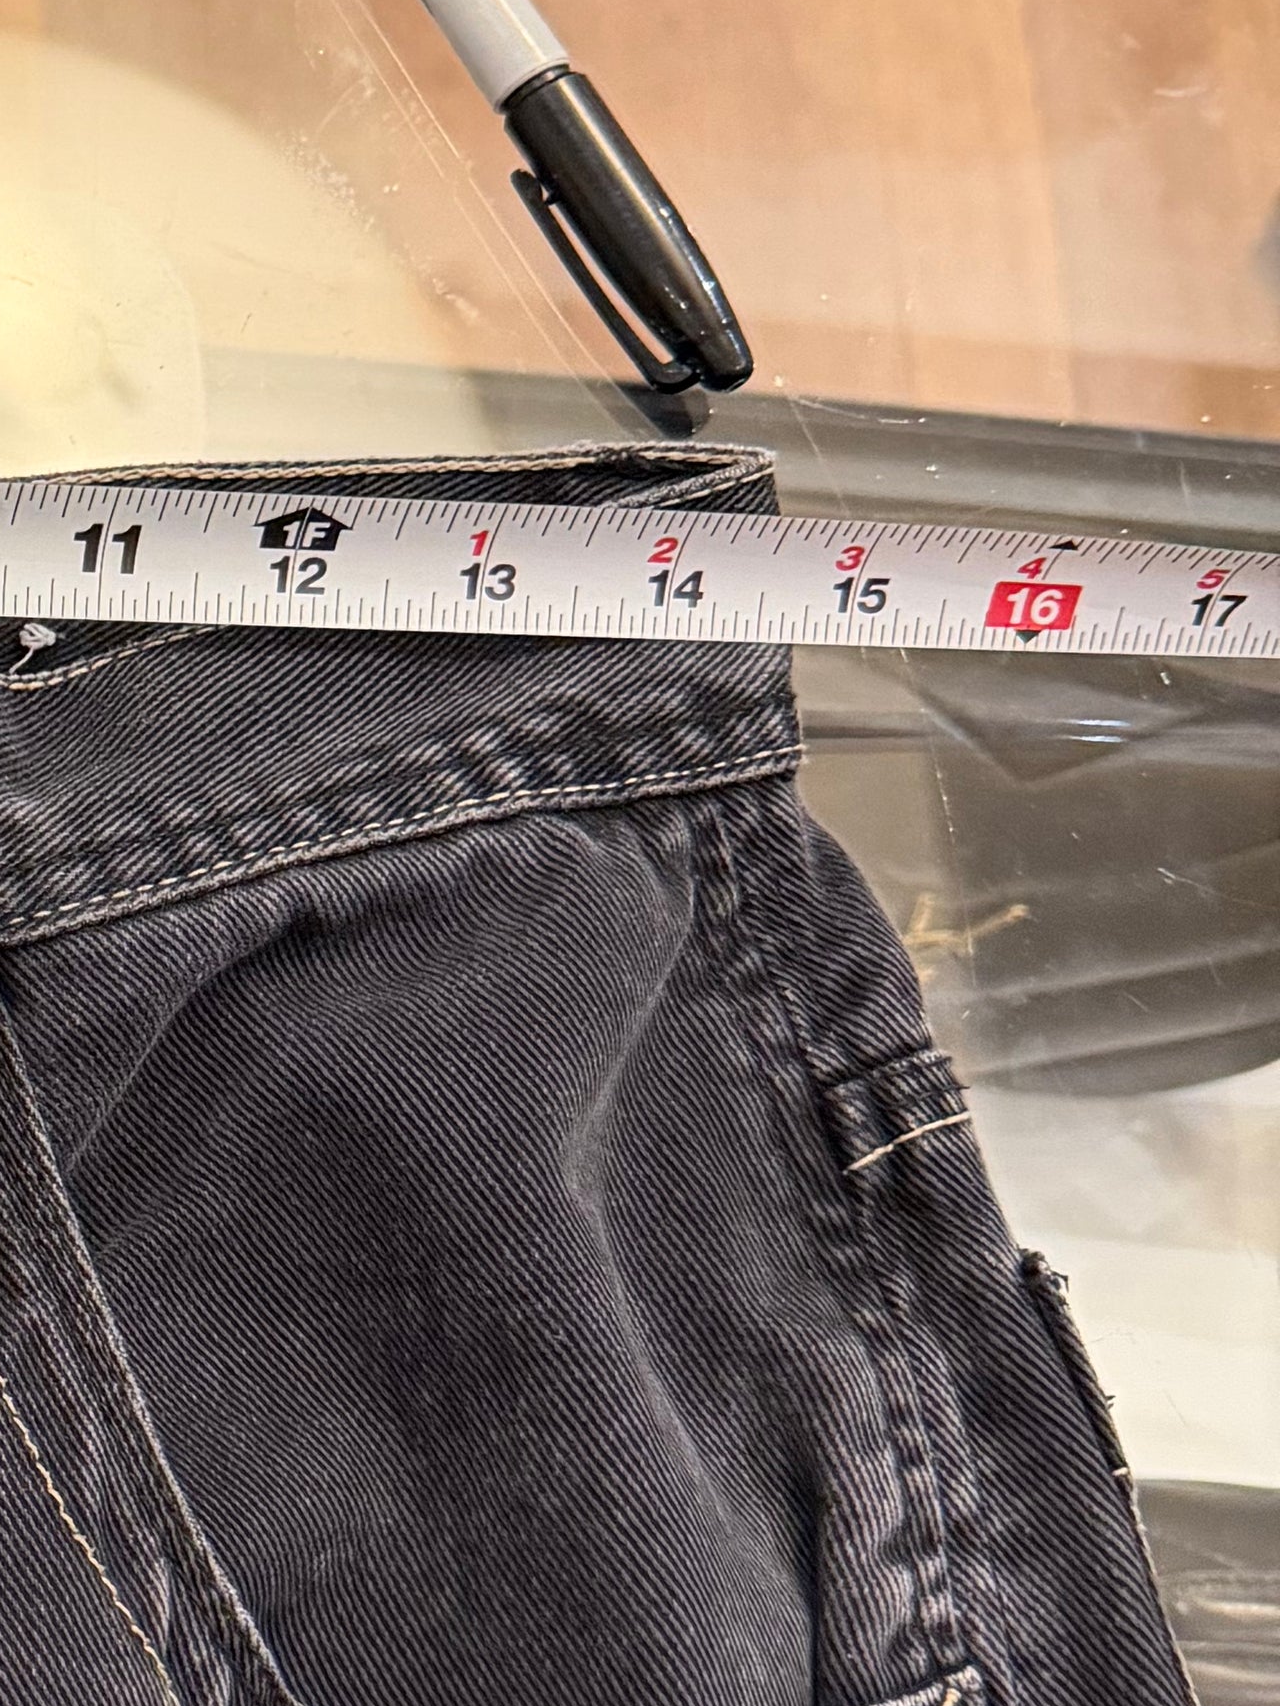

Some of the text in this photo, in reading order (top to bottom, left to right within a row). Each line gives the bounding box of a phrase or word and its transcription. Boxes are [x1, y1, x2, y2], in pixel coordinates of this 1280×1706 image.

[73, 523, 142, 575] 11
[283, 521, 331, 548] 1F
[469, 530, 488, 556] 1
[647, 537, 680, 564] 2
[269, 555, 327, 595] 12
[835, 545, 866, 572] 3
[1017, 556, 1048, 580] 4
[460, 563, 517, 601] 13
[647, 569, 704, 609] 14
[832, 577, 890, 614] 15
[1196, 568, 1232, 590] 5
[1006, 588, 1065, 626] 16
[1190, 593, 1248, 628] 17
